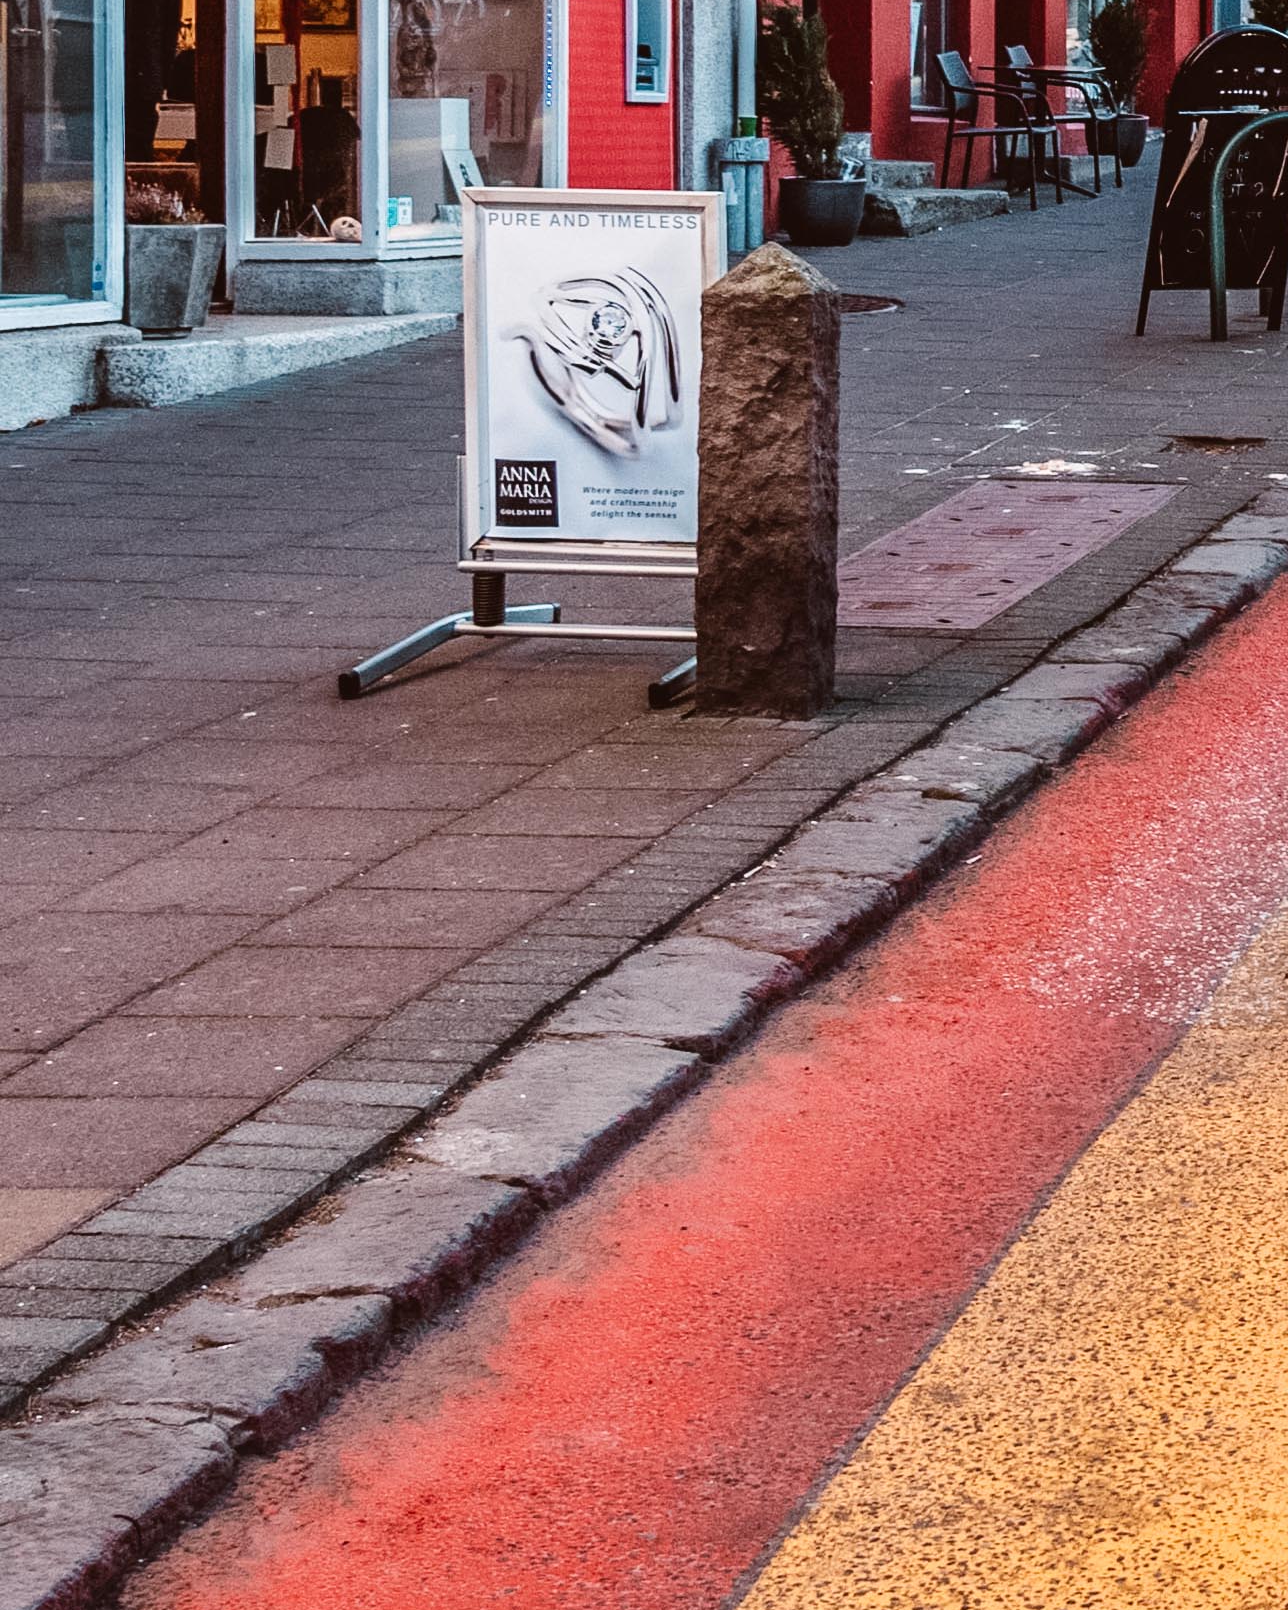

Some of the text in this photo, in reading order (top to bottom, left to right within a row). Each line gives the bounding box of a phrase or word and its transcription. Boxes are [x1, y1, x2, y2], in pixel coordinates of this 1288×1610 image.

[488, 212, 698, 230] PURE AND TIMELESS
[500, 466, 551, 482] ANNA
[500, 483, 552, 498] MARIA
[582, 486, 611, 495] Where
[652, 488, 685, 497] design
[609, 499, 677, 508] craftsmanship
[500, 508, 552, 516] GOLDSMITH
[590, 510, 624, 519] delight
[626, 510, 642, 518] the
